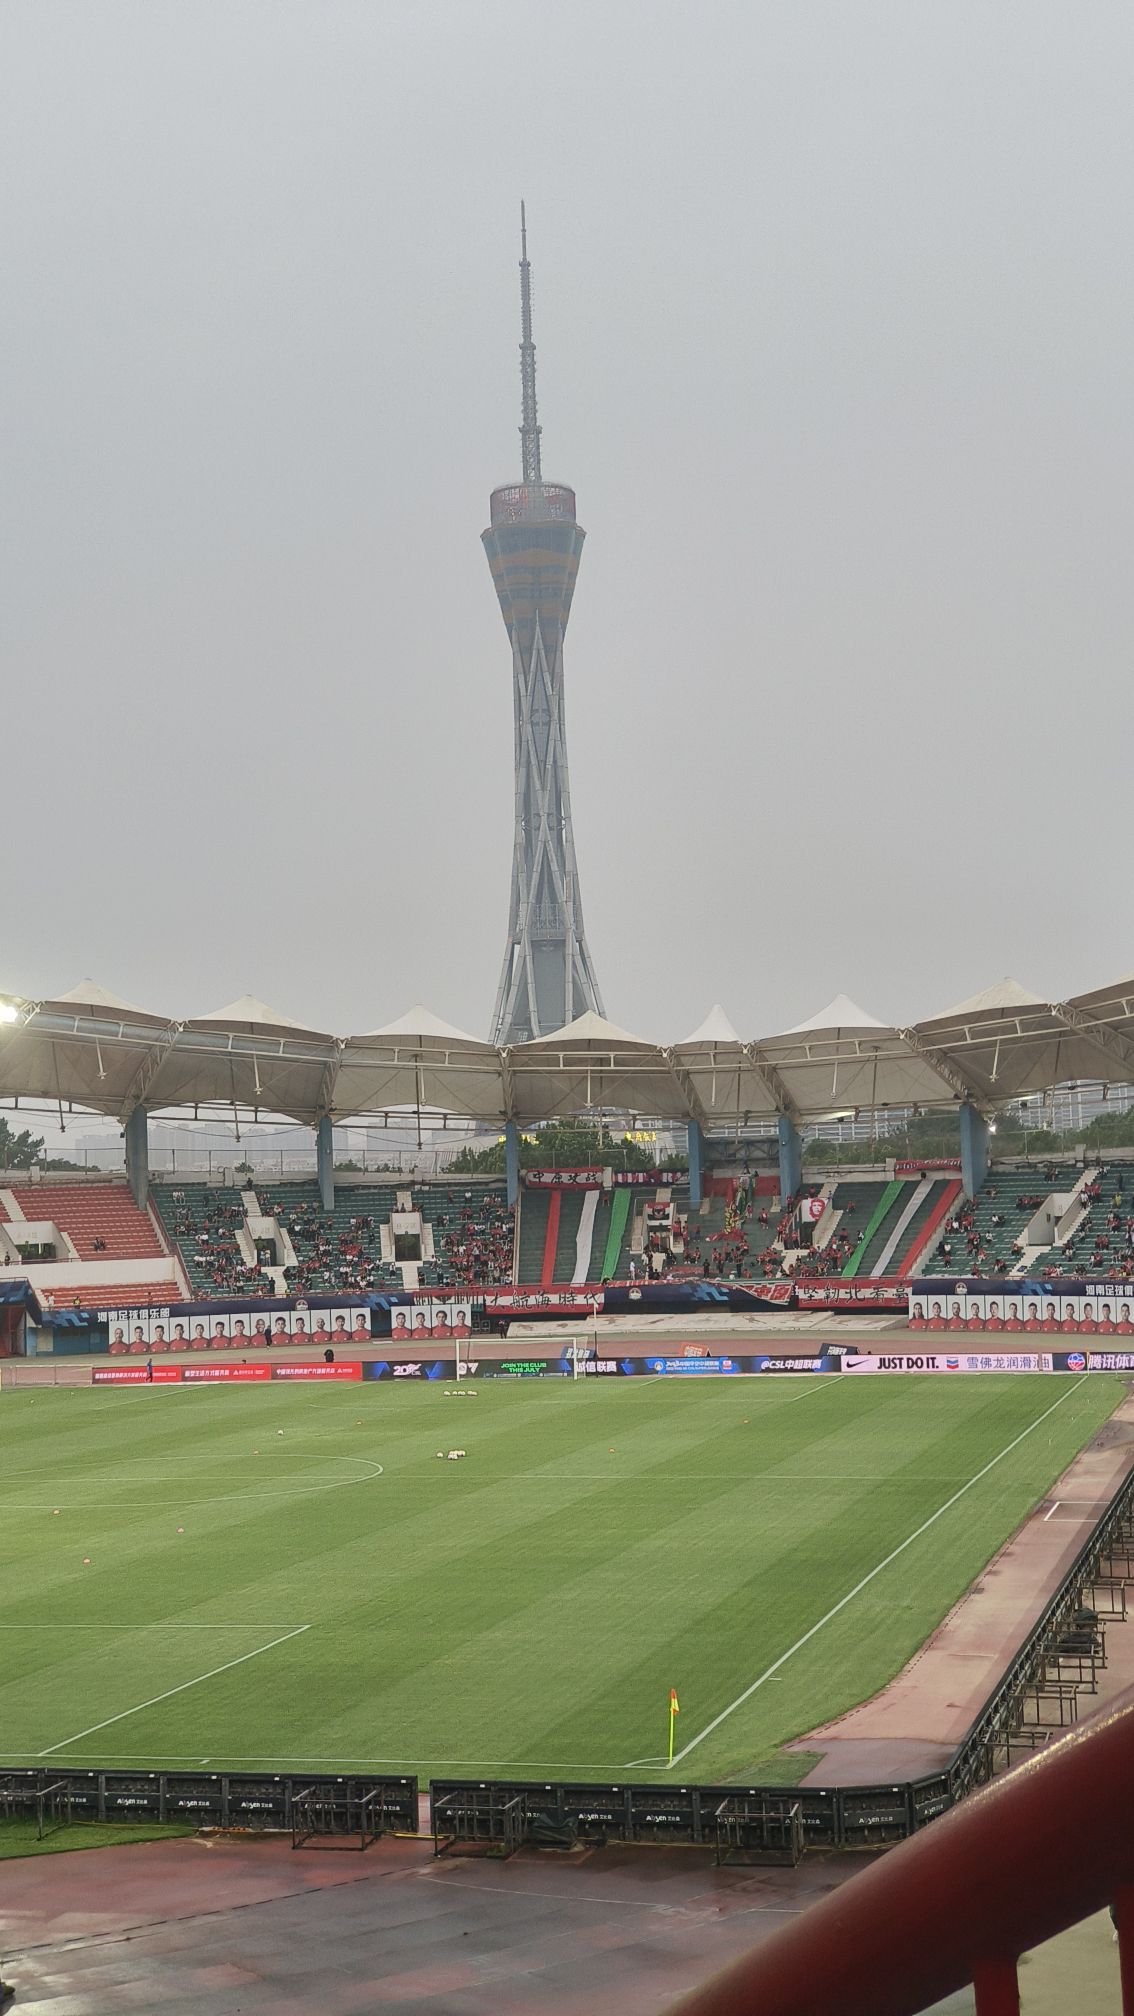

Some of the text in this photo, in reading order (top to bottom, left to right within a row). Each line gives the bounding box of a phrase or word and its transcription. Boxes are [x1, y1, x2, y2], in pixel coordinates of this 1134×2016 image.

[97, 1307, 170, 1322] 河南足球俱乐部
[877, 1357, 939, 1370] JUST DO IT.
[966, 1356, 1050, 1370] 雪佛龙润滑油
